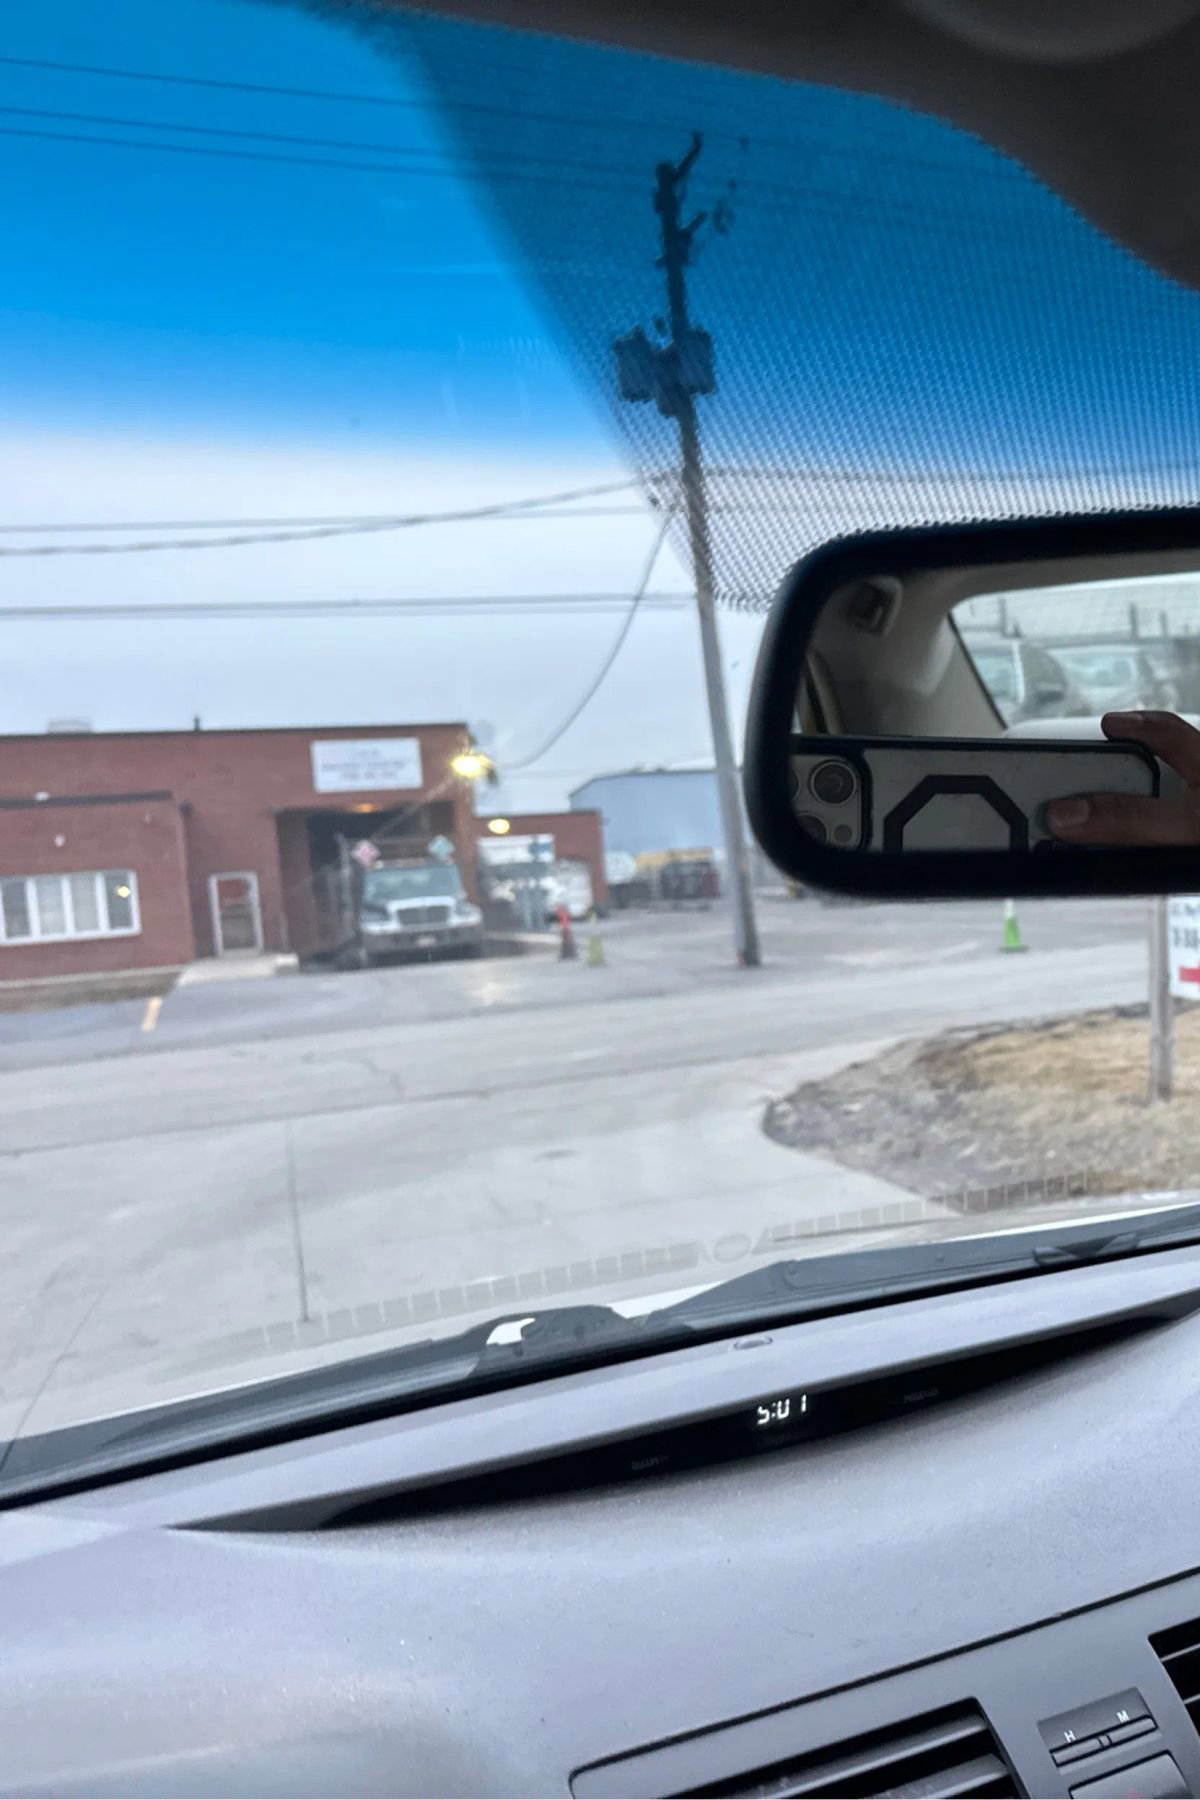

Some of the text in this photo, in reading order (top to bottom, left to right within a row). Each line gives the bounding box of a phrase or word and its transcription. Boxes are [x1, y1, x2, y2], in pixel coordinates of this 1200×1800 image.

[757, 1394, 807, 1425] 5:01
[1116, 1710, 1130, 1723] M
[1063, 1730, 1076, 1743] H
